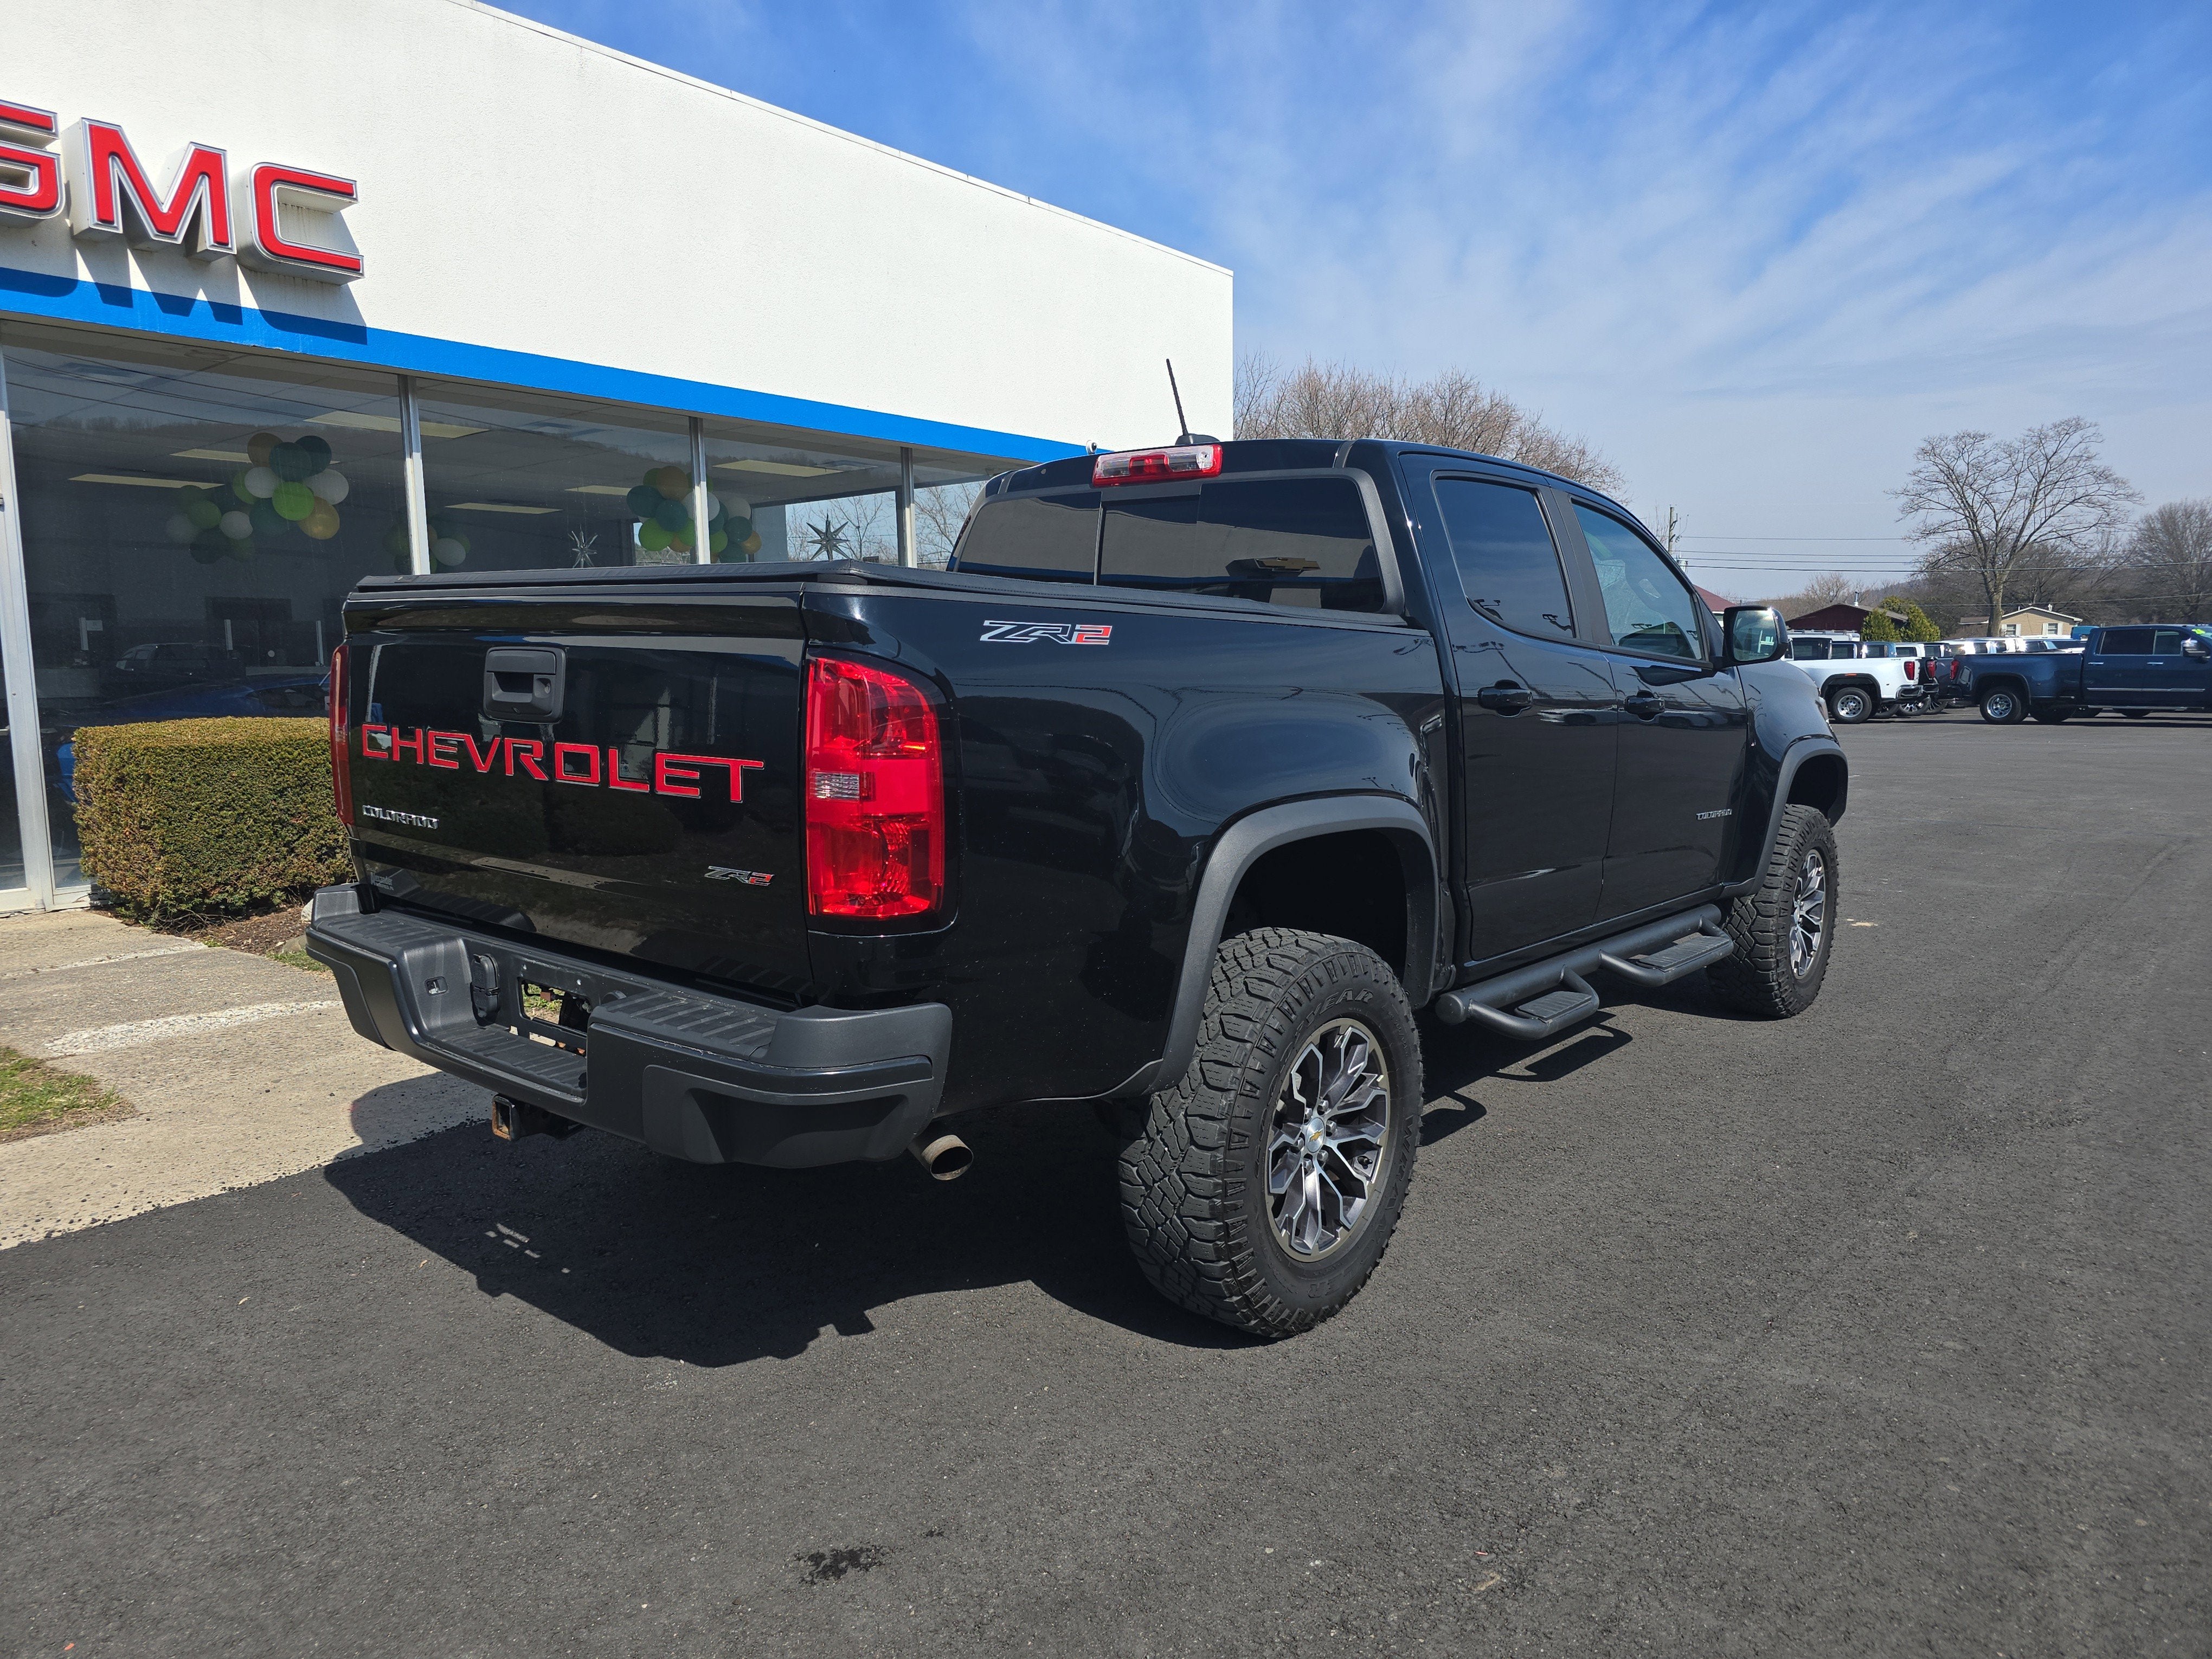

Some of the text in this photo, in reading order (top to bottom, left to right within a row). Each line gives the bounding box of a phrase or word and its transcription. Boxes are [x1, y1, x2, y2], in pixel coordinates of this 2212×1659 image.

[980, 620, 1113, 645] ZR2
[362, 723, 765, 802] CHEVROLET
[362, 805, 440, 829] COLORADO
[704, 865, 775, 886] ZR2
